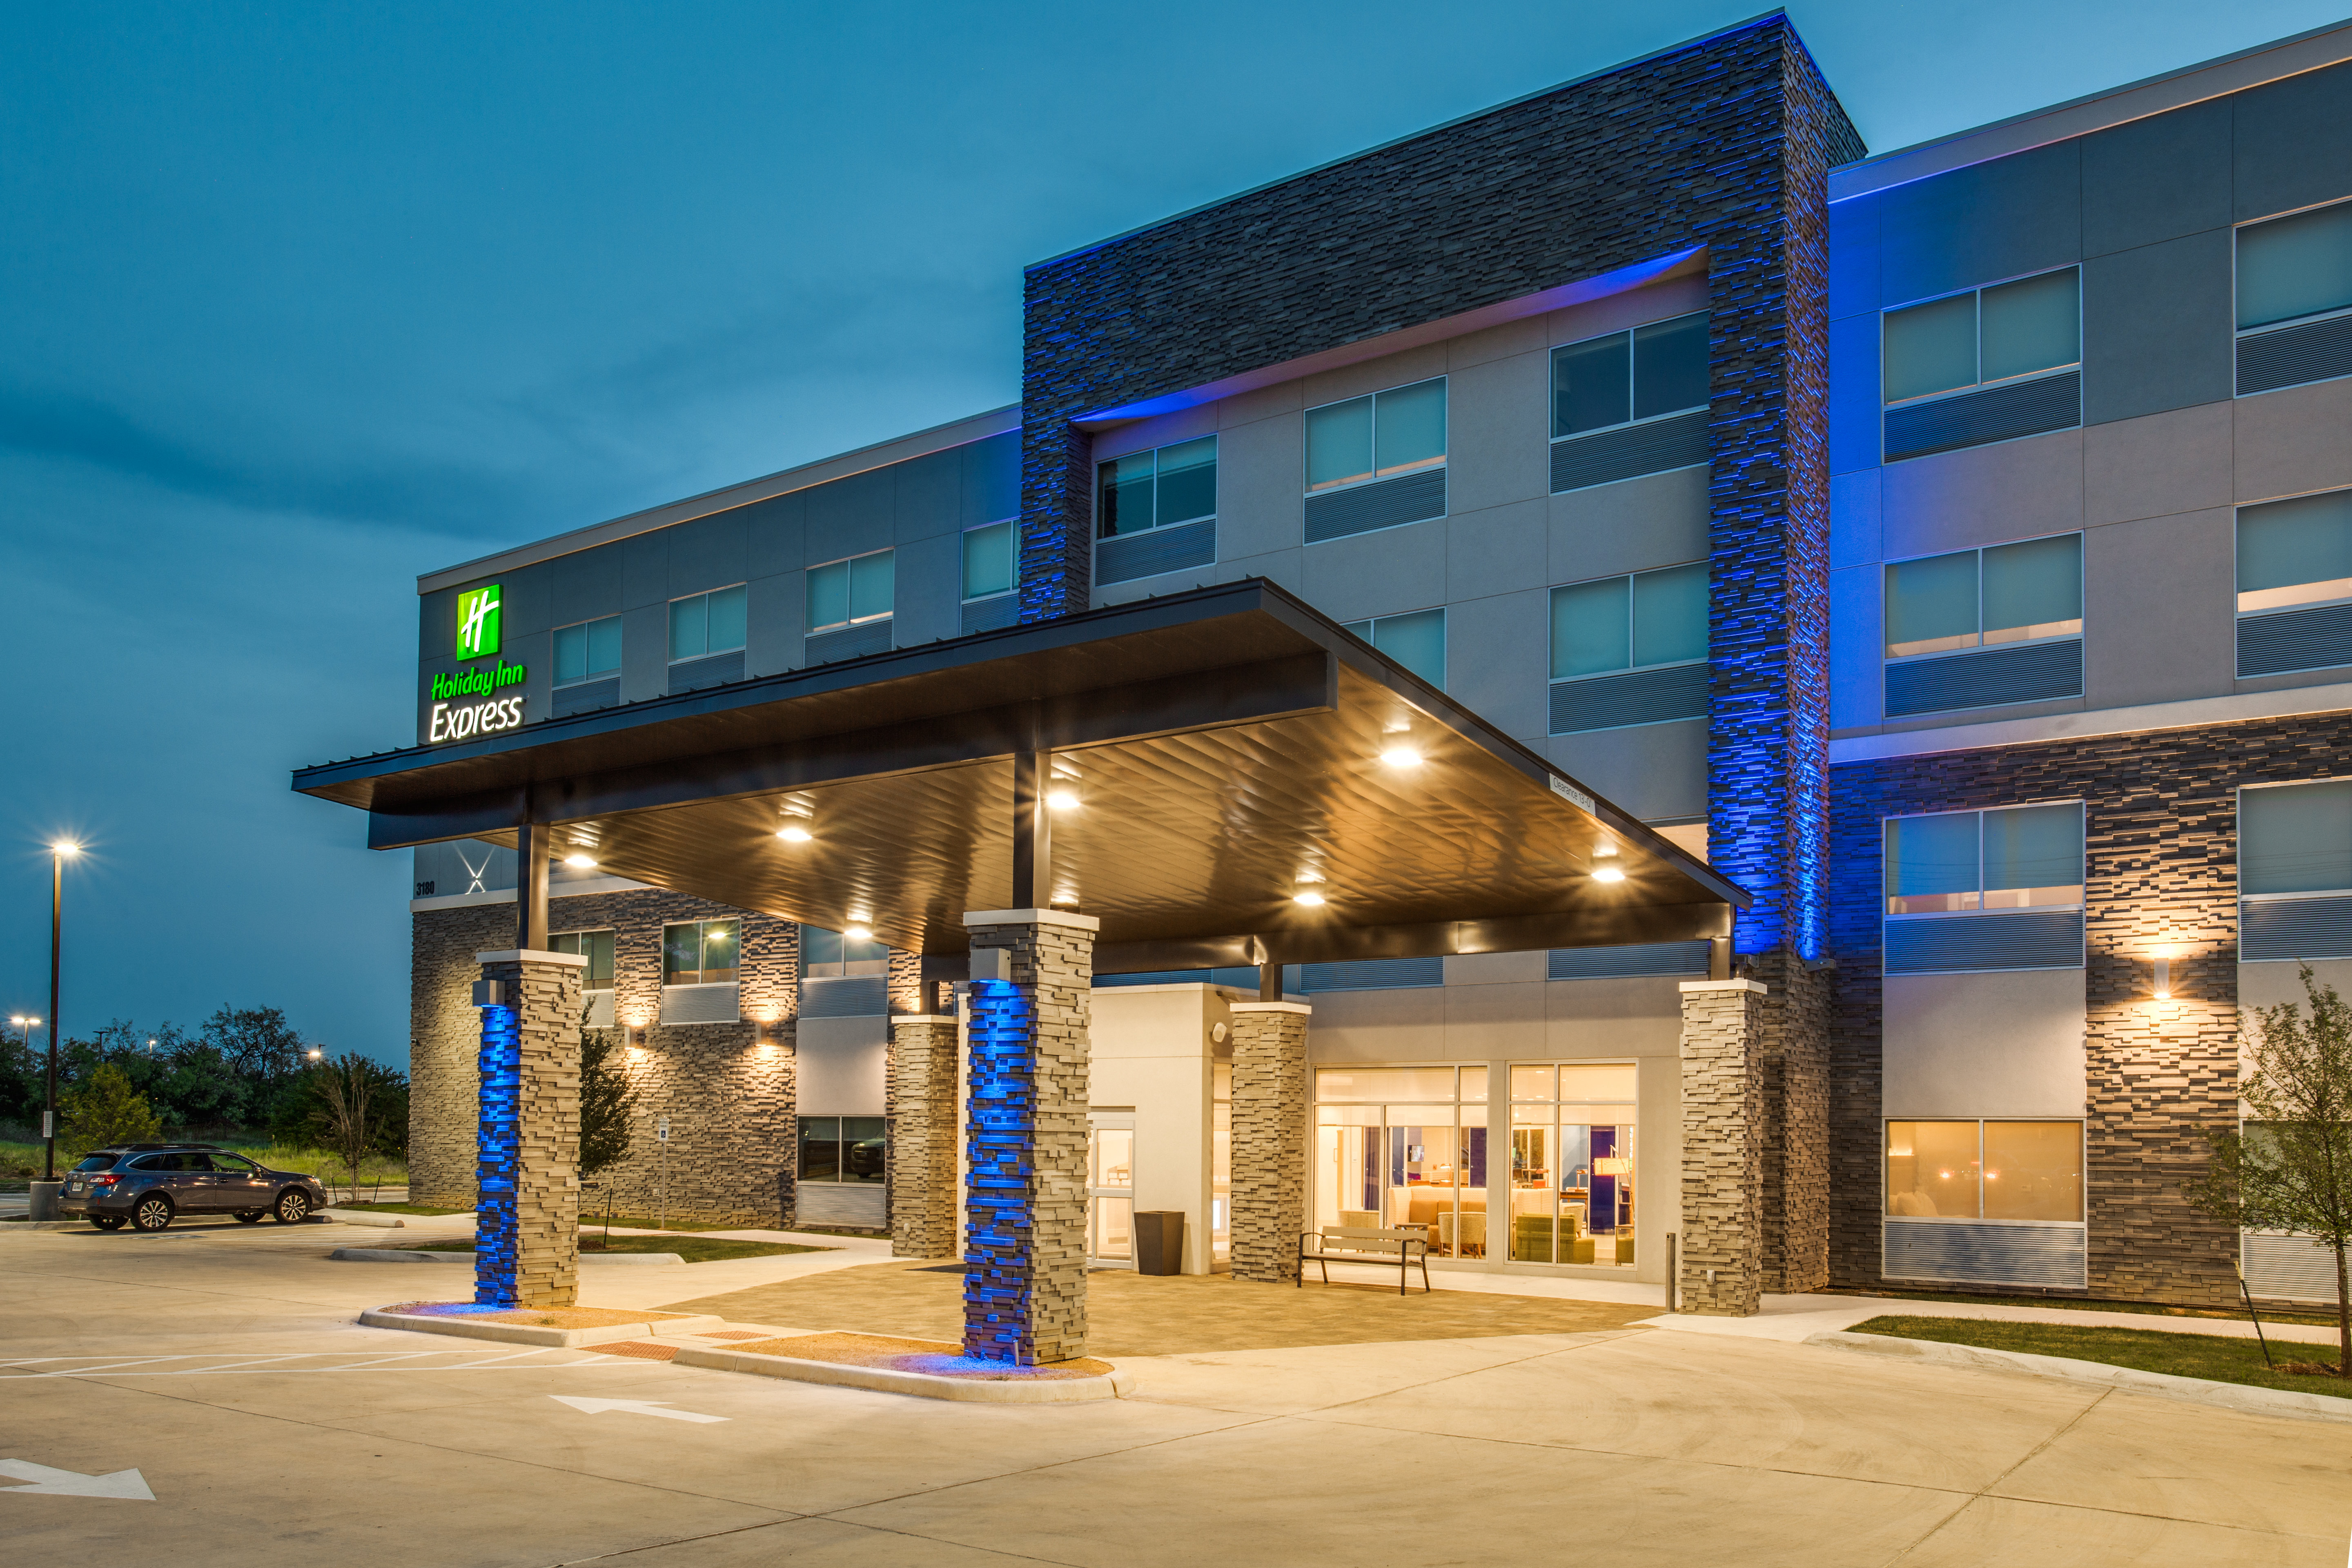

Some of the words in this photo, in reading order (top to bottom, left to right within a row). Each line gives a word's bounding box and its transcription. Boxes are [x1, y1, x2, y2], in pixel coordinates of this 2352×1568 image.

[431, 667, 494, 700] Holiday
[496, 660, 523, 687] Inn
[430, 697, 522, 742] Express
[1553, 777, 1577, 800] Clearance
[416, 881, 434, 895] 3180
